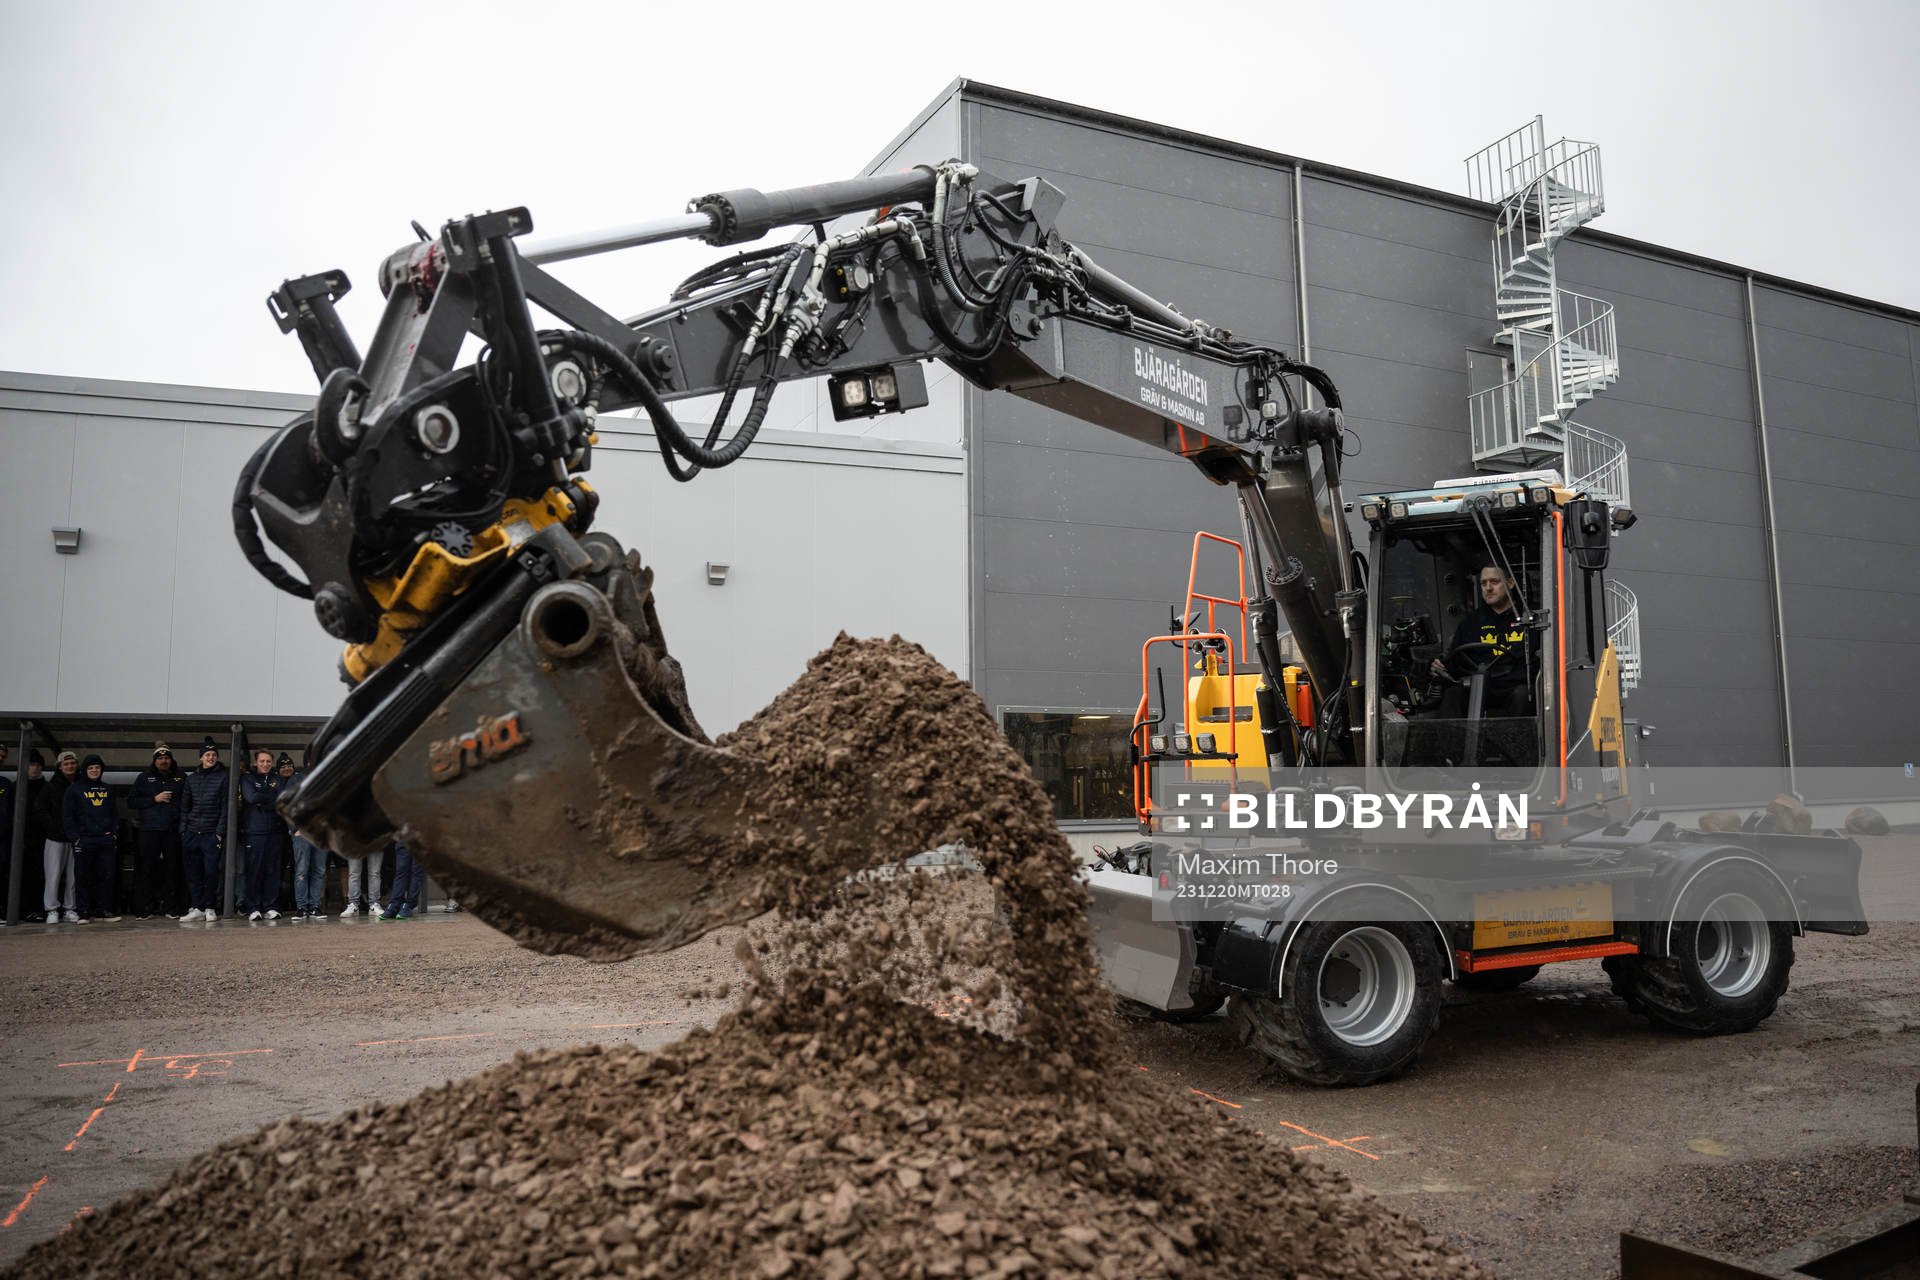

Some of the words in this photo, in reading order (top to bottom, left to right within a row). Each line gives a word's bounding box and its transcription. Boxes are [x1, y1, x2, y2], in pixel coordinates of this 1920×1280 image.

[1134, 347, 1208, 406] BJÄRAGÅRDEN
[1141, 387, 1160, 407] GRÄV
[1167, 398, 1195, 422] MASKIN
[1195, 410, 1205, 426] AB
